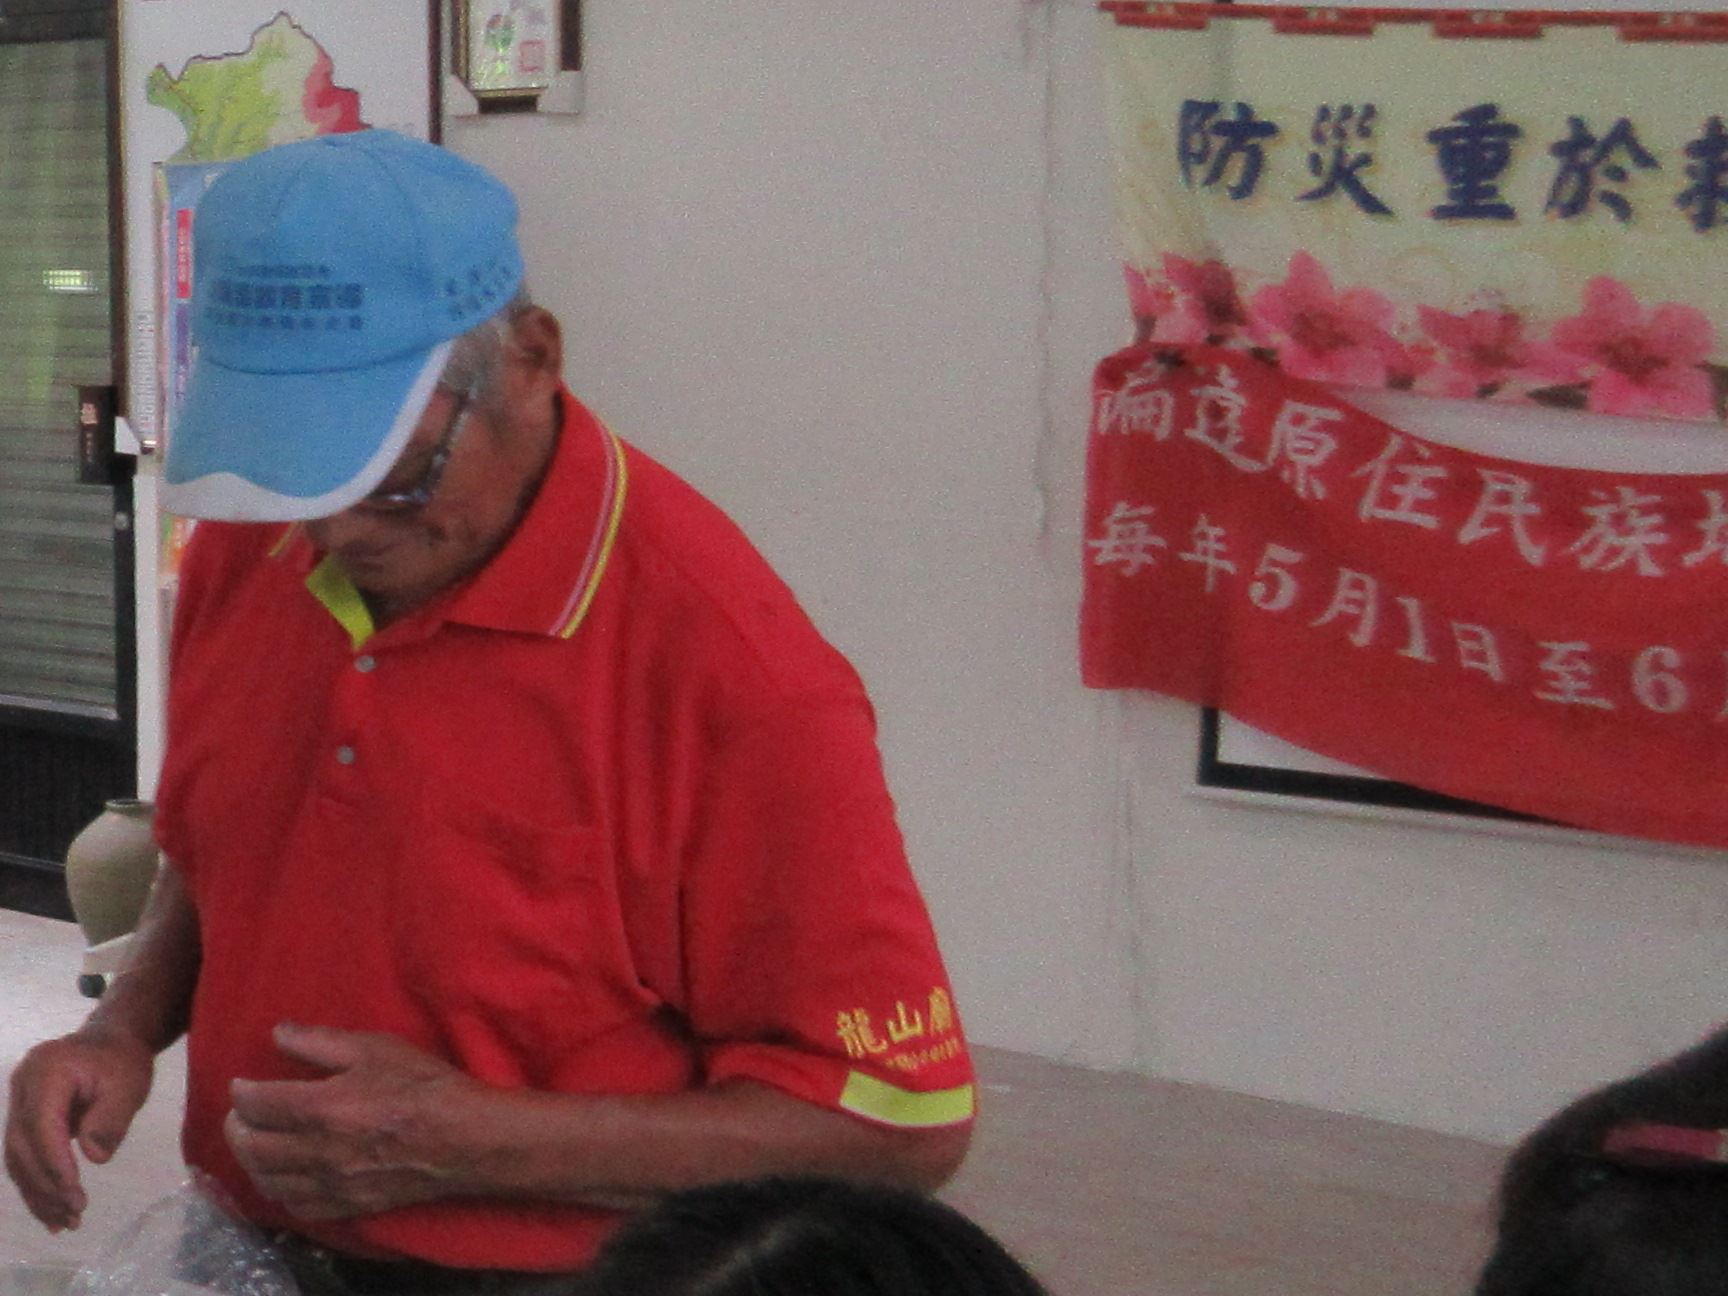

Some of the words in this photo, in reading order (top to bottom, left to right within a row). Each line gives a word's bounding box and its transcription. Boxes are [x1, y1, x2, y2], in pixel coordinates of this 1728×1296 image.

[1087, 500, 1728, 722] 每年5月1日至6
